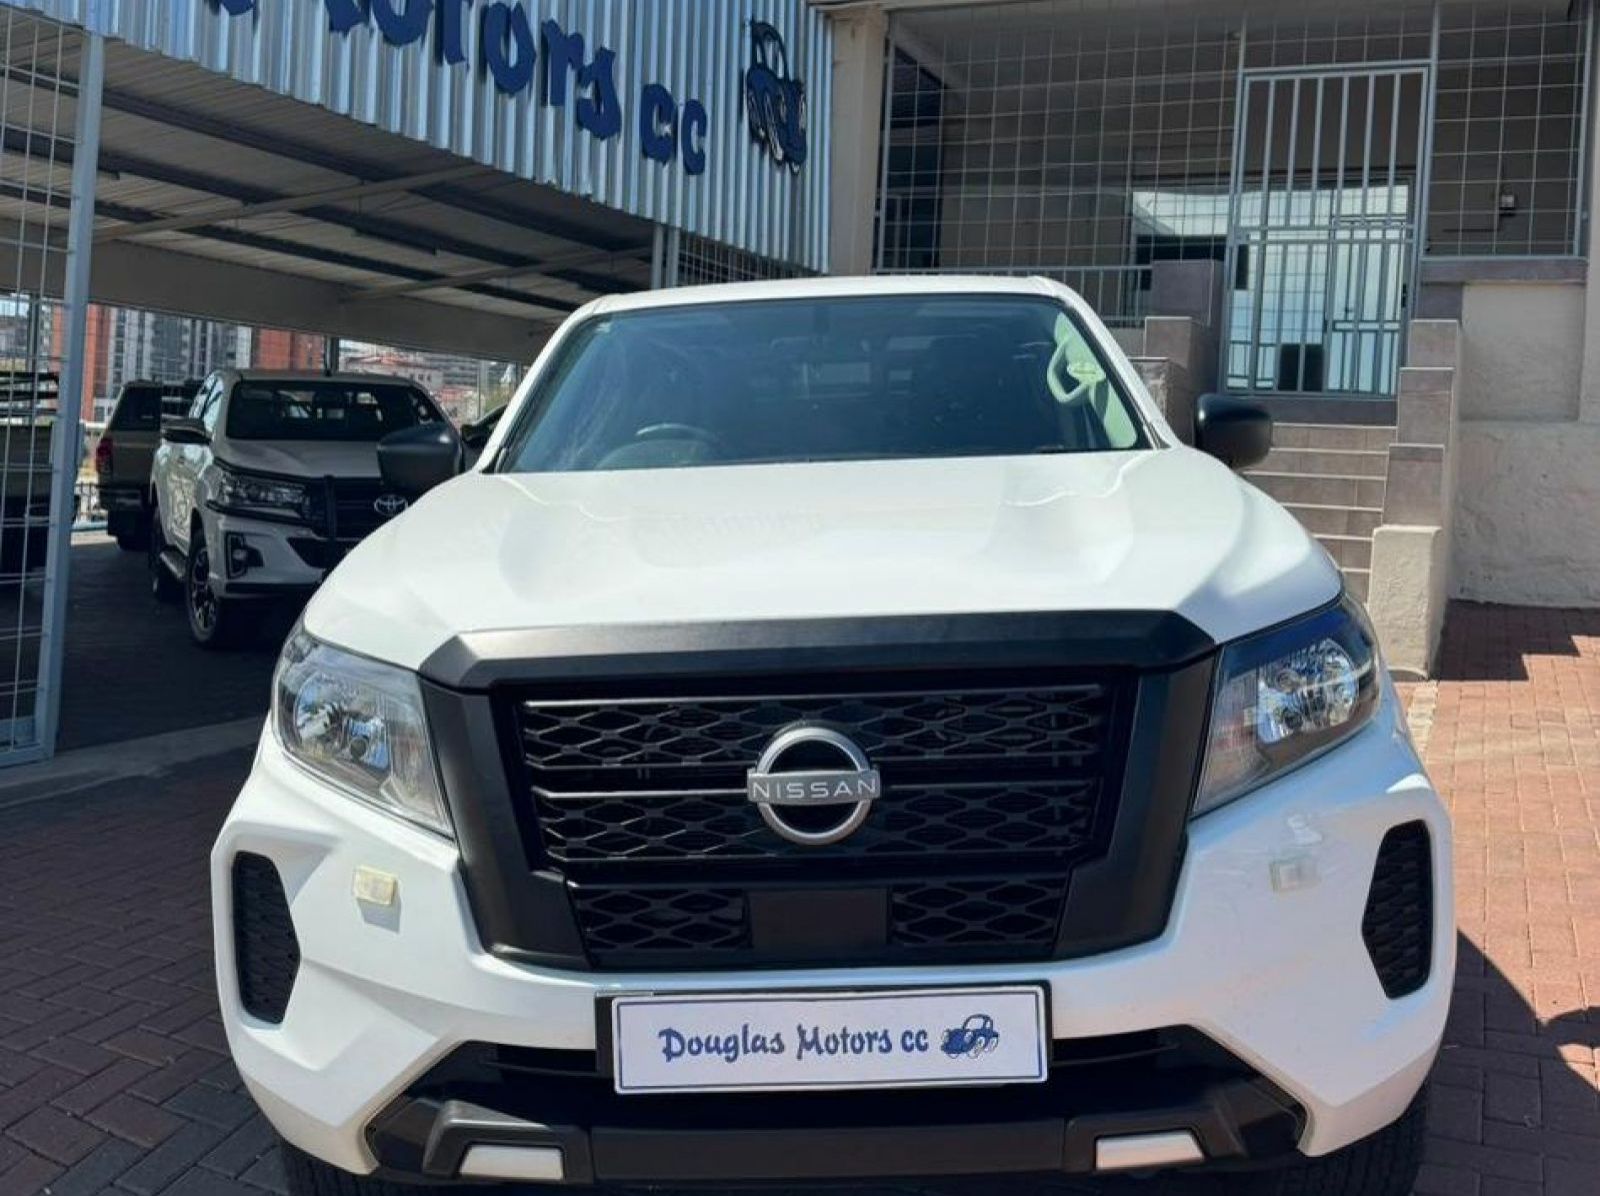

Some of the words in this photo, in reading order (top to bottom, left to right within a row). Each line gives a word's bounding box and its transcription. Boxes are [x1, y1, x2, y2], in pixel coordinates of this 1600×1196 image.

[219, 0, 621, 140] tors
[641, 84, 707, 175] cc
[753, 779, 876, 799] NISSAN
[658, 1023, 785, 1063] Douglas
[797, 1023, 892, 1061] Motors
[901, 1029, 928, 1052] cc
